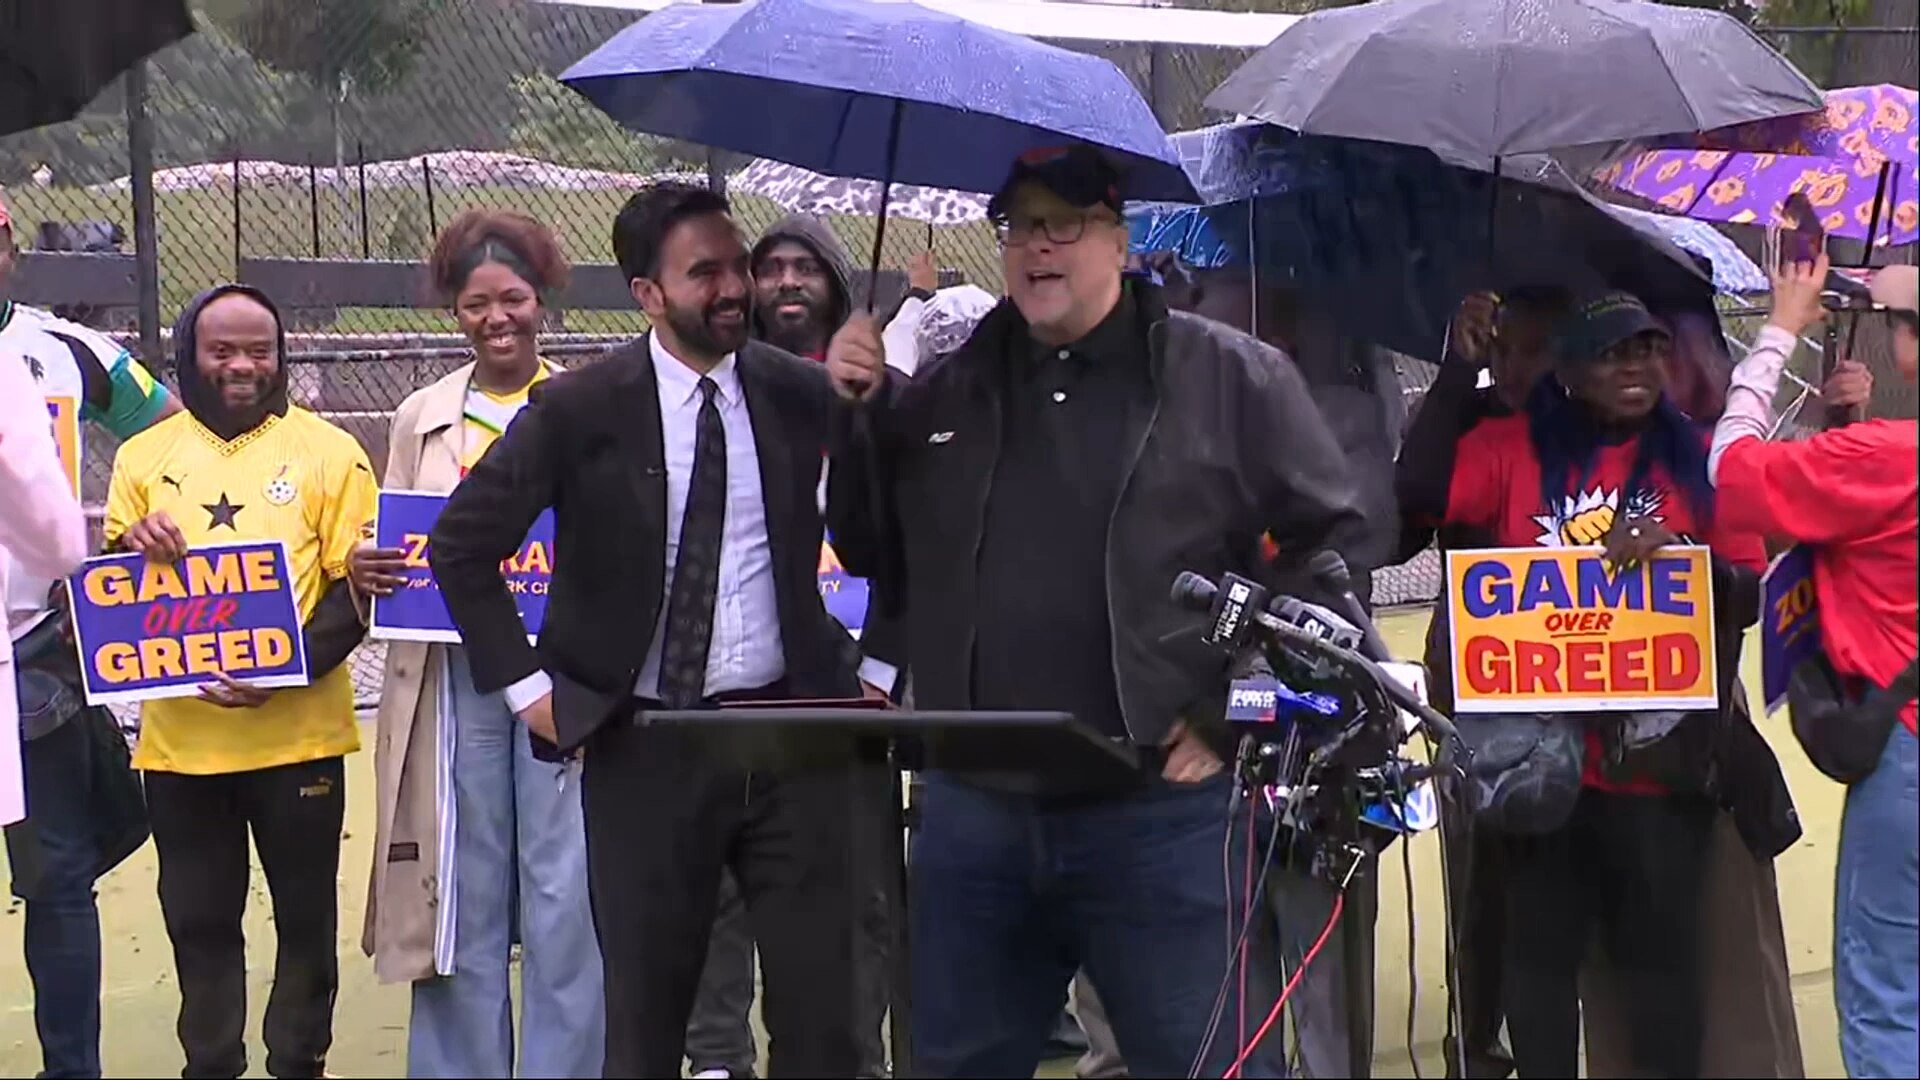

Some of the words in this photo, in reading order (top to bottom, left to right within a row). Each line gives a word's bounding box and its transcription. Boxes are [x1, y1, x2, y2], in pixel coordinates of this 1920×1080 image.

[84, 550, 280, 605] GAME
[1462, 558, 1694, 618] GAME
[142, 599, 238, 635] OVER
[1545, 612, 1614, 632] OVER
[94, 628, 293, 684] GREED
[1465, 633, 1701, 694] GREED
